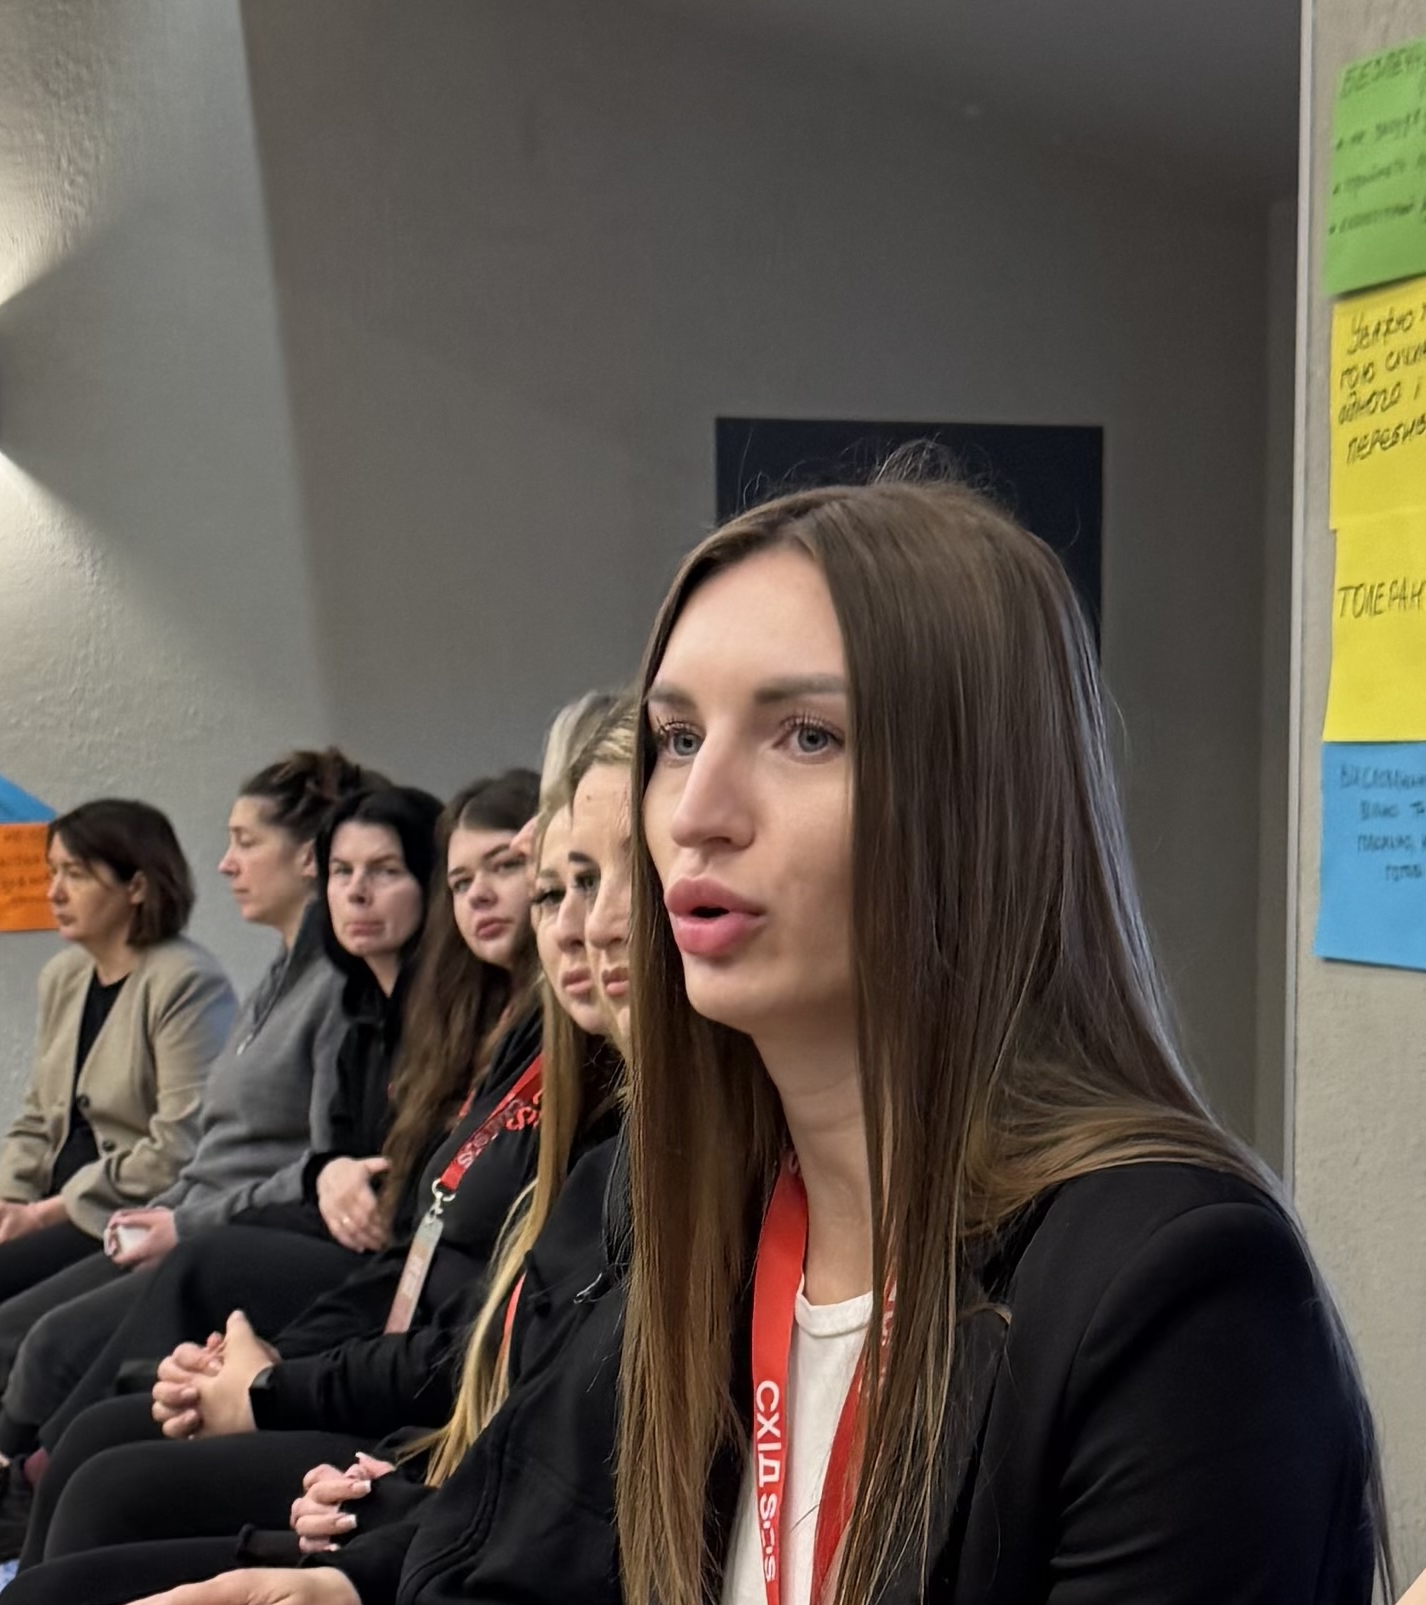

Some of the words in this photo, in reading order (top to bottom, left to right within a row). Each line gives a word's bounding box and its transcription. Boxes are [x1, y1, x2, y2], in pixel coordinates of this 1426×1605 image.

[1346, 307, 1413, 355] УВАЖНО
[756, 1379, 782, 1488] СХІД
[759, 1492, 778, 1583] SOS
